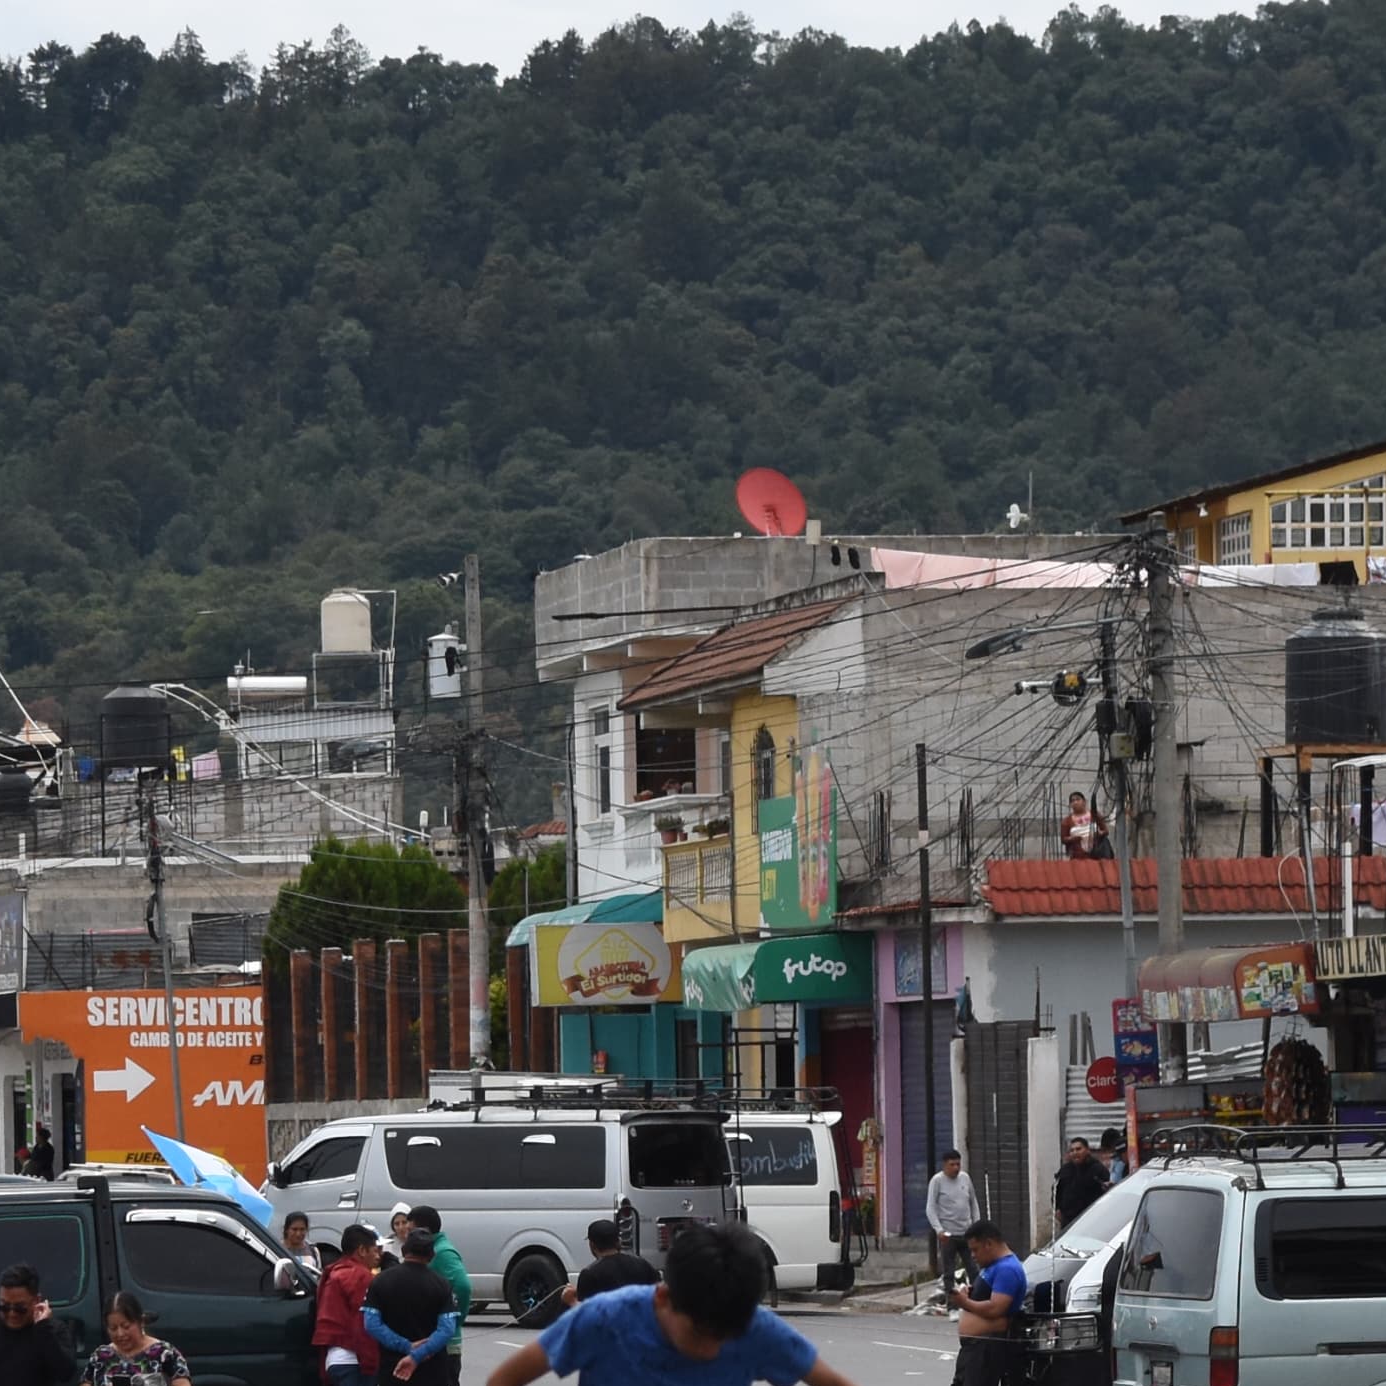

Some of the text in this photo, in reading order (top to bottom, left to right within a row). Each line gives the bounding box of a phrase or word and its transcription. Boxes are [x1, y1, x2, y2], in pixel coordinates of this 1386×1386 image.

[783, 953, 848, 984] frutop
[580, 971, 647, 993] El Surtidor
[129, 1031, 185, 1047] CAMBO
[189, 1031, 204, 1047] DE
[206, 1031, 252, 1047] ACEITE
